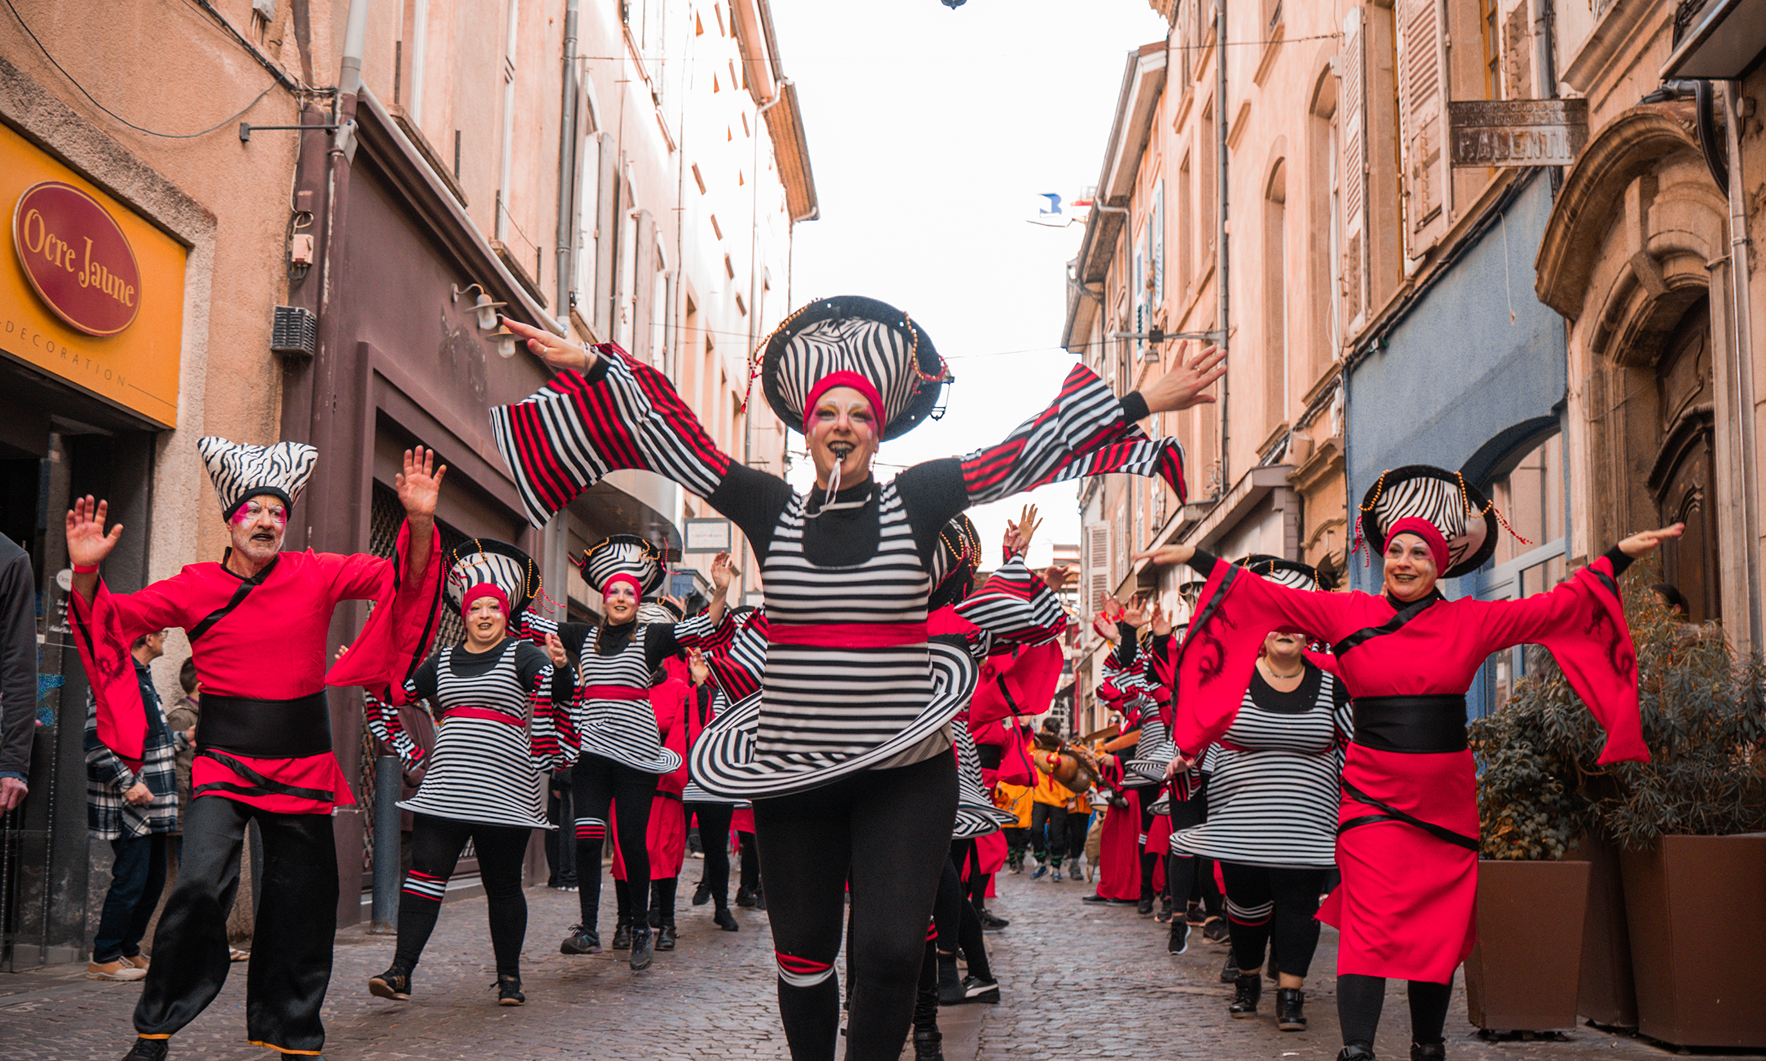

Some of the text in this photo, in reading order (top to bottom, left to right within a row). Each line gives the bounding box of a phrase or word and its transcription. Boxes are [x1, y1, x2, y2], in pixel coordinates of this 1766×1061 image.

[24, 208, 135, 307] Ocre Jaune
[5, 320, 126, 386] DECORATION
